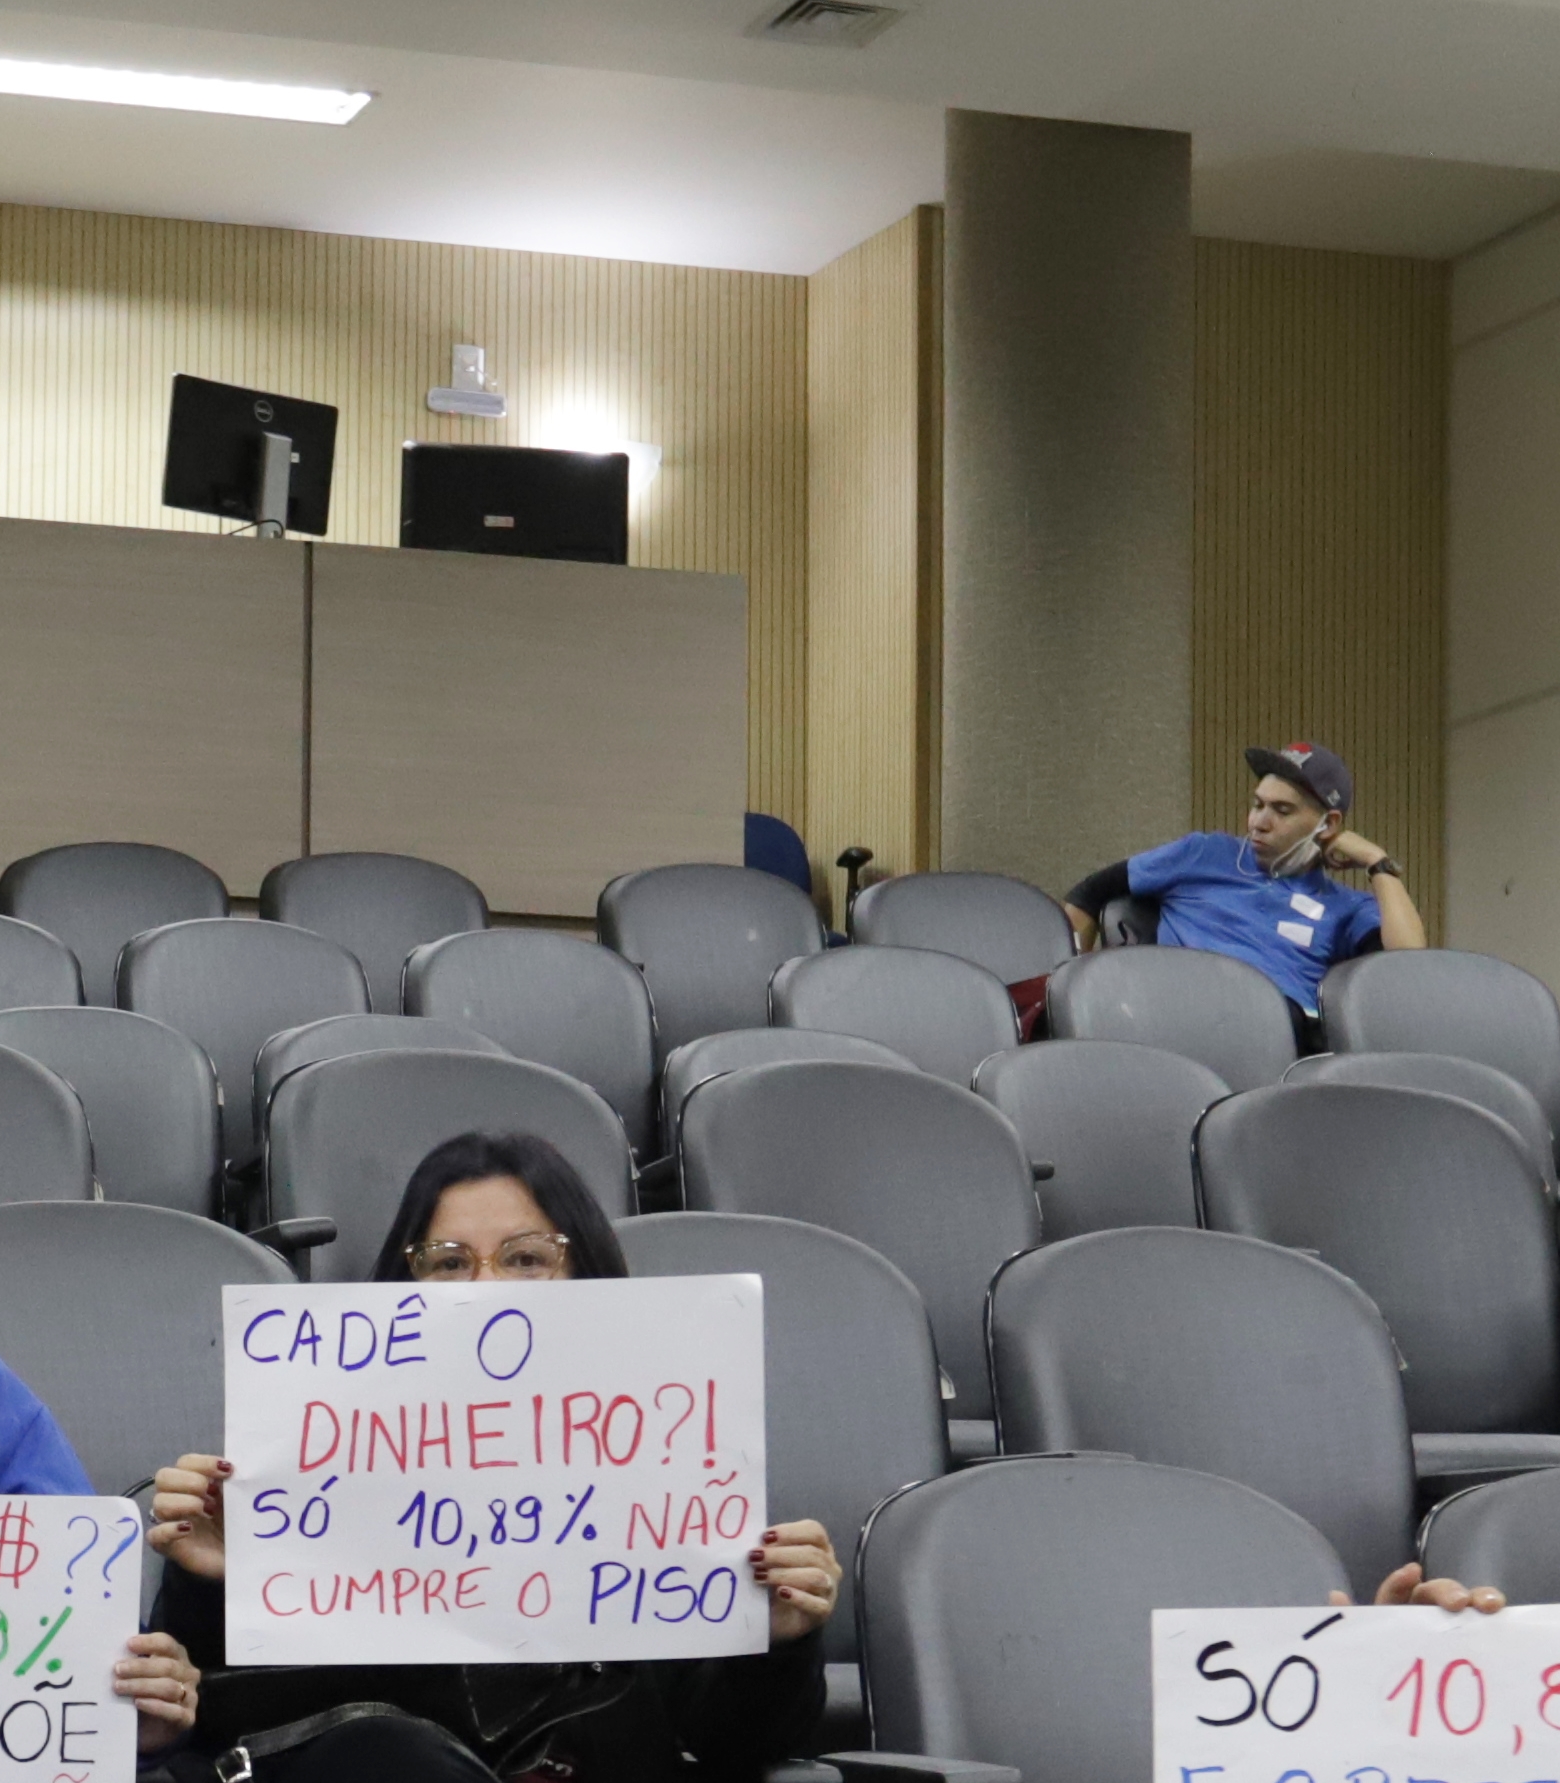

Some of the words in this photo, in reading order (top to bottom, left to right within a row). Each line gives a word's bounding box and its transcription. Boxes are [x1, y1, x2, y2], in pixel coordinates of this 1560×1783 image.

[242, 1293, 427, 1372] CADÊ
[477, 1309, 533, 1380] O
[298, 1378, 718, 1474] DINHEIRO?!
[253, 1475, 339, 1539] SÓ
[396, 1484, 598, 1559] 10,89%
[626, 1470, 750, 1551] NÃO
[262, 1566, 492, 1617] CUMPRE
[517, 1572, 551, 1618] O
[589, 1561, 738, 1625] PISO
[1195, 1612, 1344, 1732] SÓ
